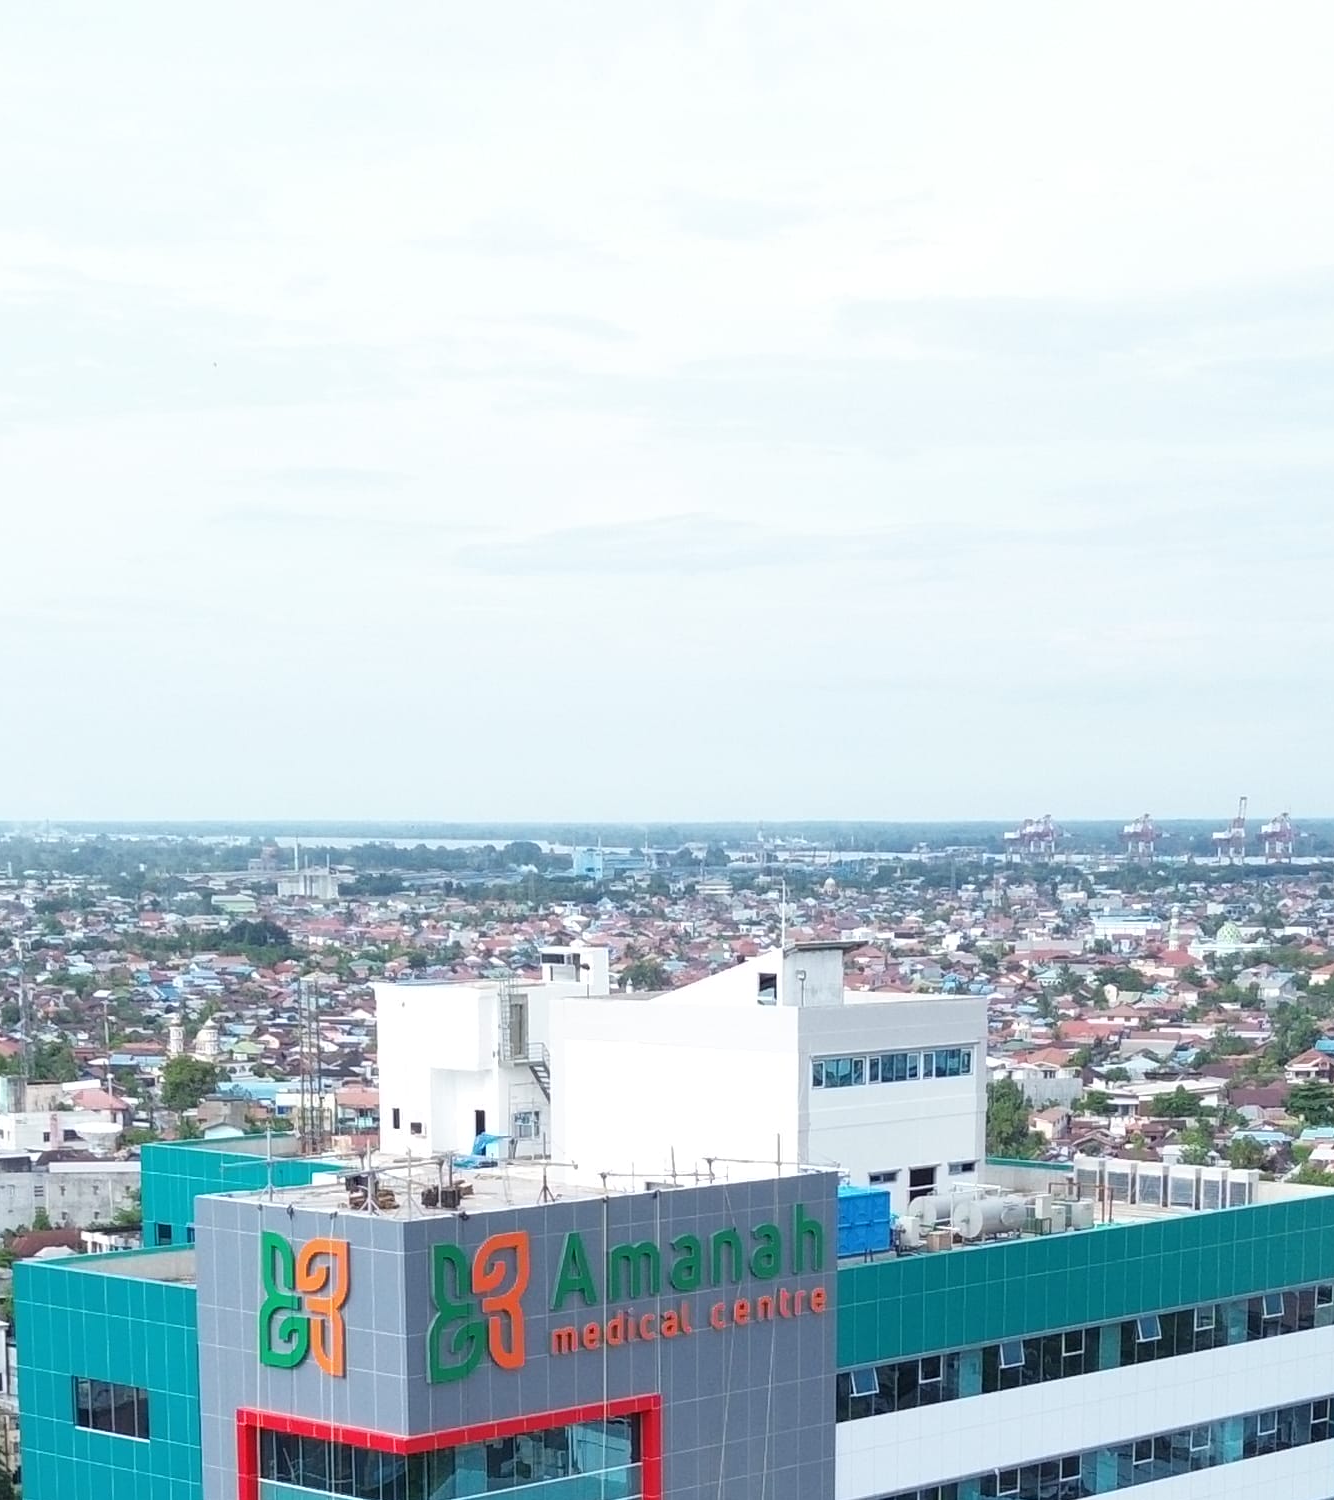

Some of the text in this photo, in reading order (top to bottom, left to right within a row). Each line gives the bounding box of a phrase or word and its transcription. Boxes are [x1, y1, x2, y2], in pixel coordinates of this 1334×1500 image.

[549, 1203, 826, 1310] Amanah
[550, 1285, 828, 1355] medical centre
